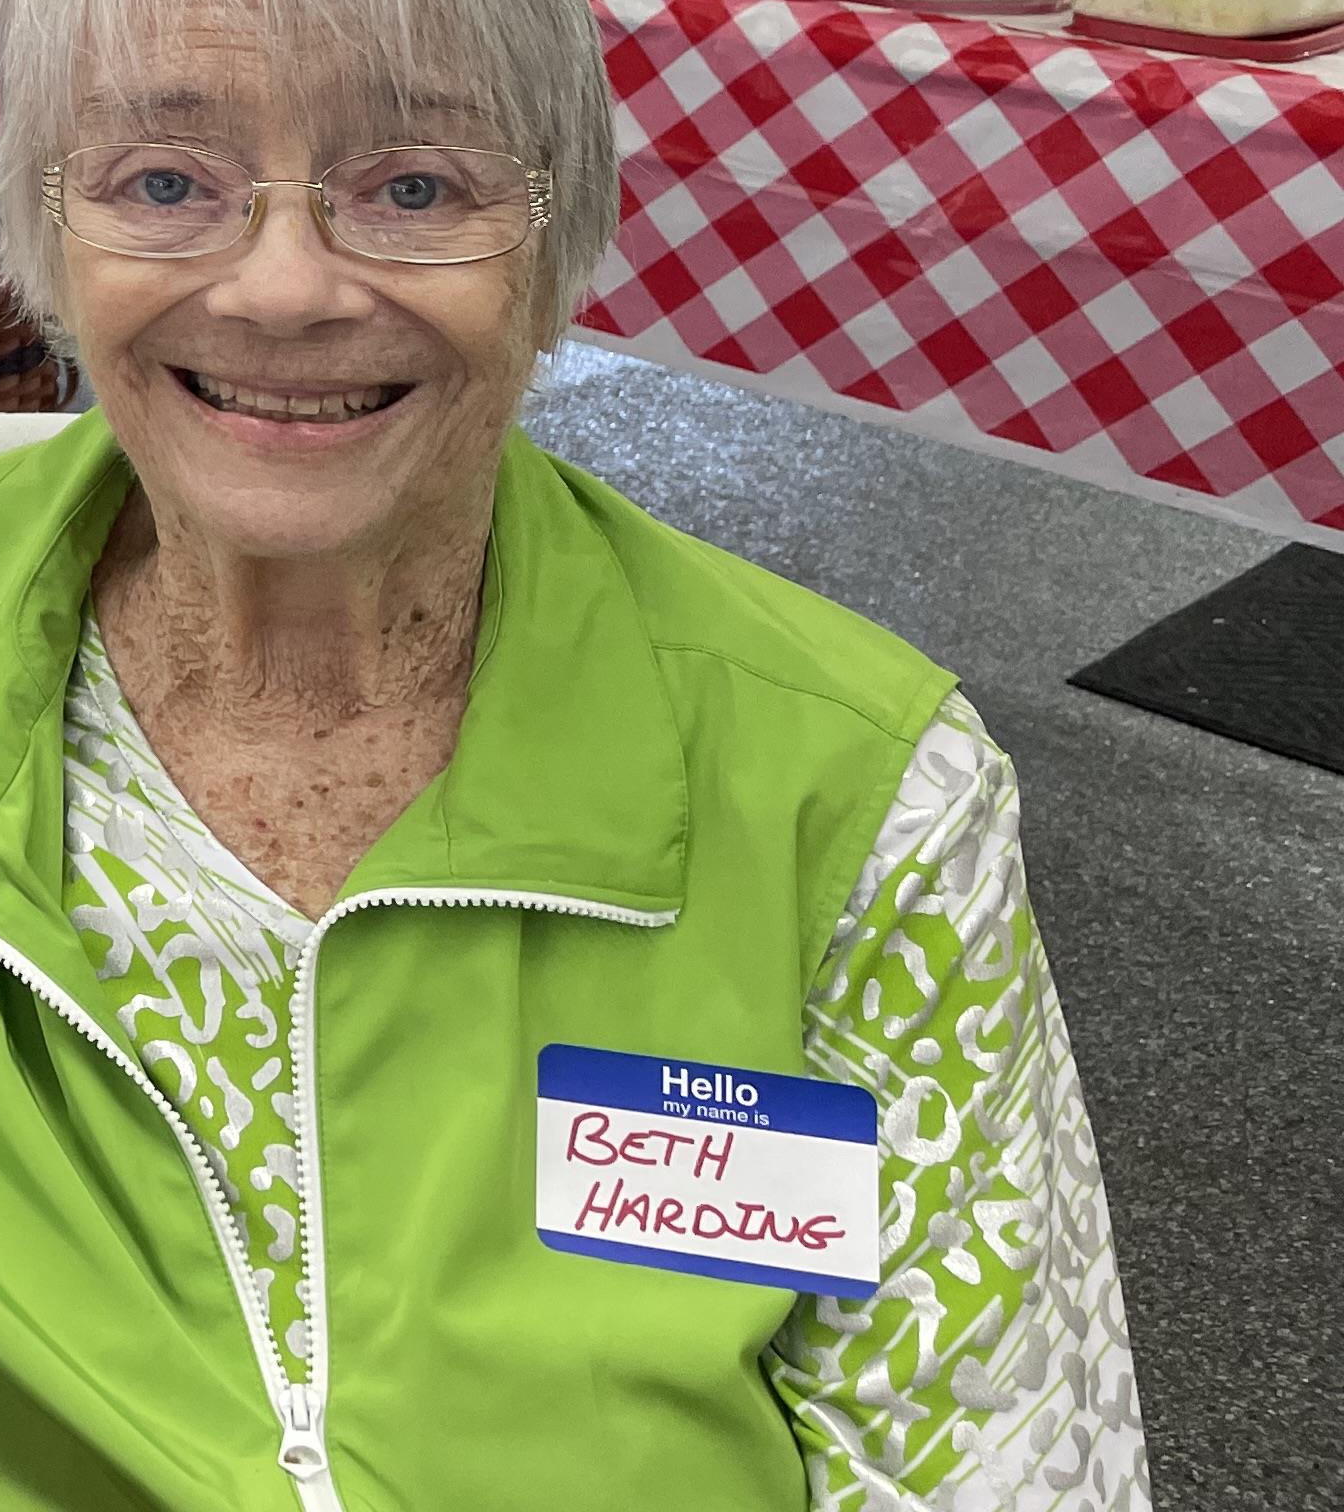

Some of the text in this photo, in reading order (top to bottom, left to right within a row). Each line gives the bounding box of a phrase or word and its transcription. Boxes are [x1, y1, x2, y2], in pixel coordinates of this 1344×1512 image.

[662, 1065, 758, 1107] Hello
[663, 1100, 770, 1126] my name is
[567, 1111, 734, 1181] BETH
[575, 1178, 845, 1250] HARDING
